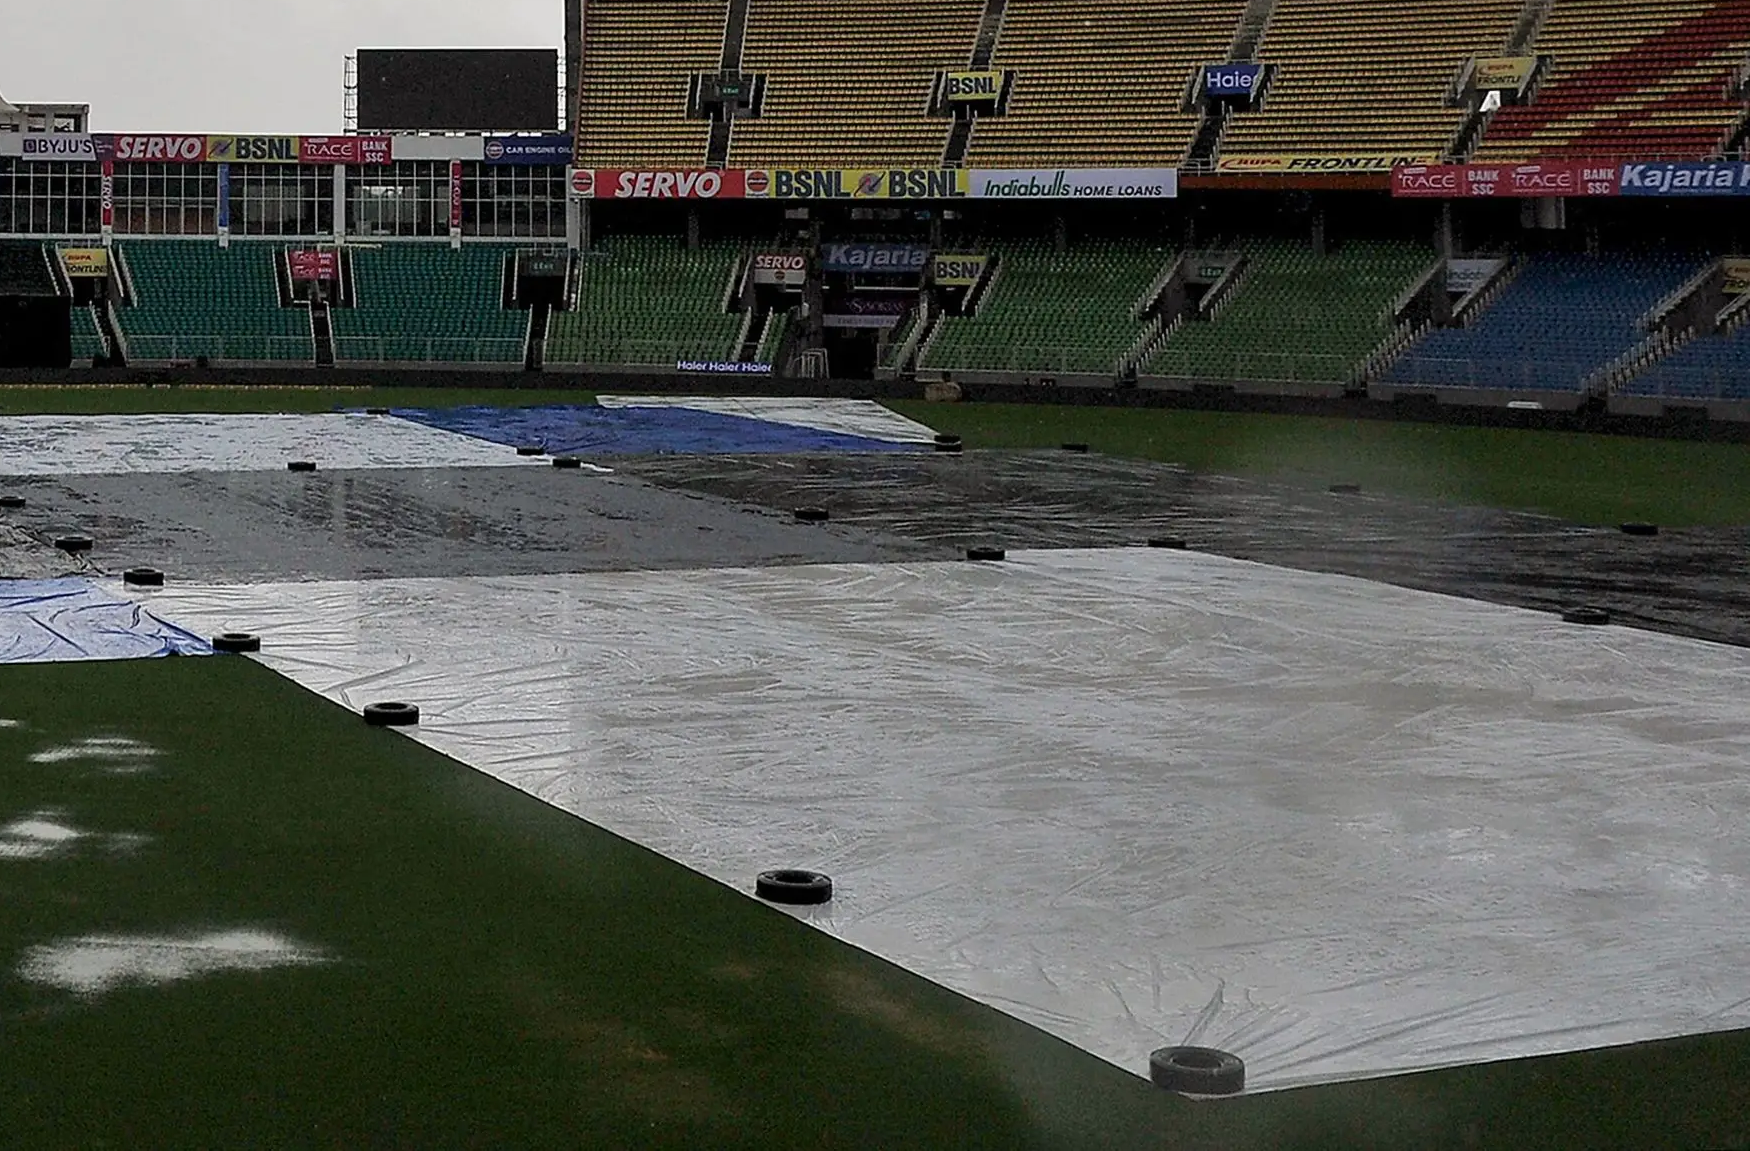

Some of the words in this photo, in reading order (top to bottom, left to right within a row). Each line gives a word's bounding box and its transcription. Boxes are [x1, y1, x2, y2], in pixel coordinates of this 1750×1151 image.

[949, 76, 997, 94] BSNL
[38, 139, 93, 153] BYJU'S
[116, 136, 202, 159] SERVO
[236, 138, 298, 159] BSNL
[362, 140, 388, 151] BANK
[365, 152, 384, 162] SSC
[984, 170, 1071, 196] Indiabulls
[1074, 186, 1114, 196] HOME
[1118, 186, 1162, 196] LOANS
[1467, 169, 1500, 181] BANK
[1583, 168, 1615, 180] BANK
[1621, 164, 1734, 192] Kajaria
[614, 171, 722, 198] SERVO
[776, 170, 851, 197] BSNL
[889, 170, 965, 197] BSNL
[1471, 182, 1495, 195] SSC
[1587, 182, 1610, 194] SSC
[754, 254, 805, 269] SERVO
[828, 244, 927, 270] Kajaria
